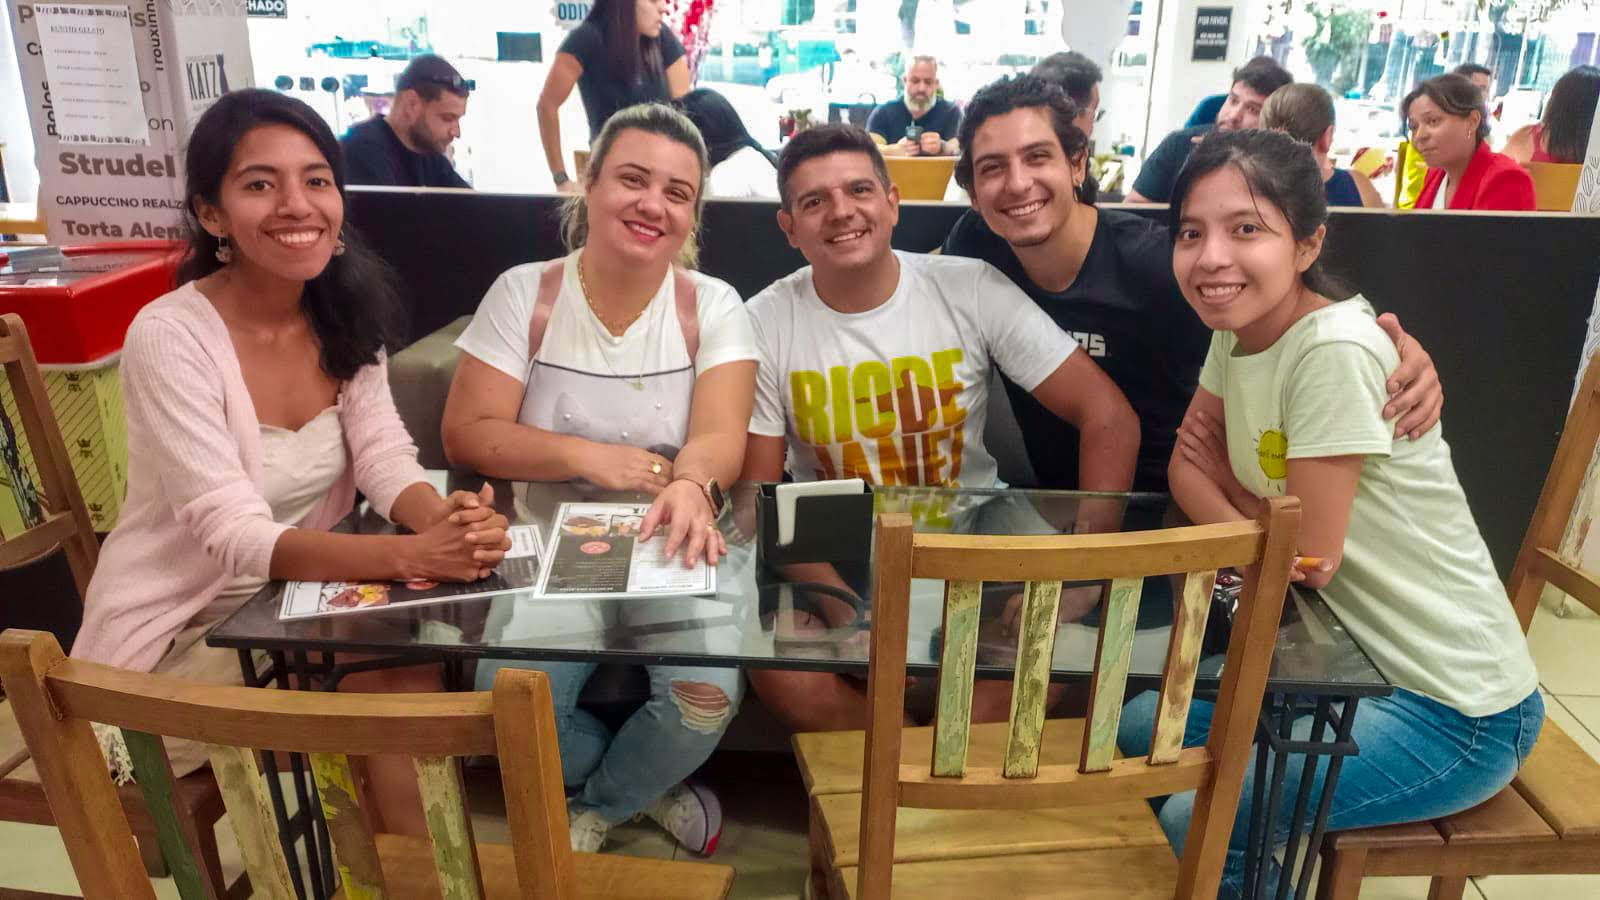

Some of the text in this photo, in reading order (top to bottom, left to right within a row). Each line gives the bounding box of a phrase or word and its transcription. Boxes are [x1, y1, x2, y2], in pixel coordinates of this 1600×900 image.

[247, 0, 284, 11] HADO
[59, 152, 176, 177] Strudel
[56, 195, 139, 208] CAPPUCCINO
[62, 220, 185, 240] Torta Alen
